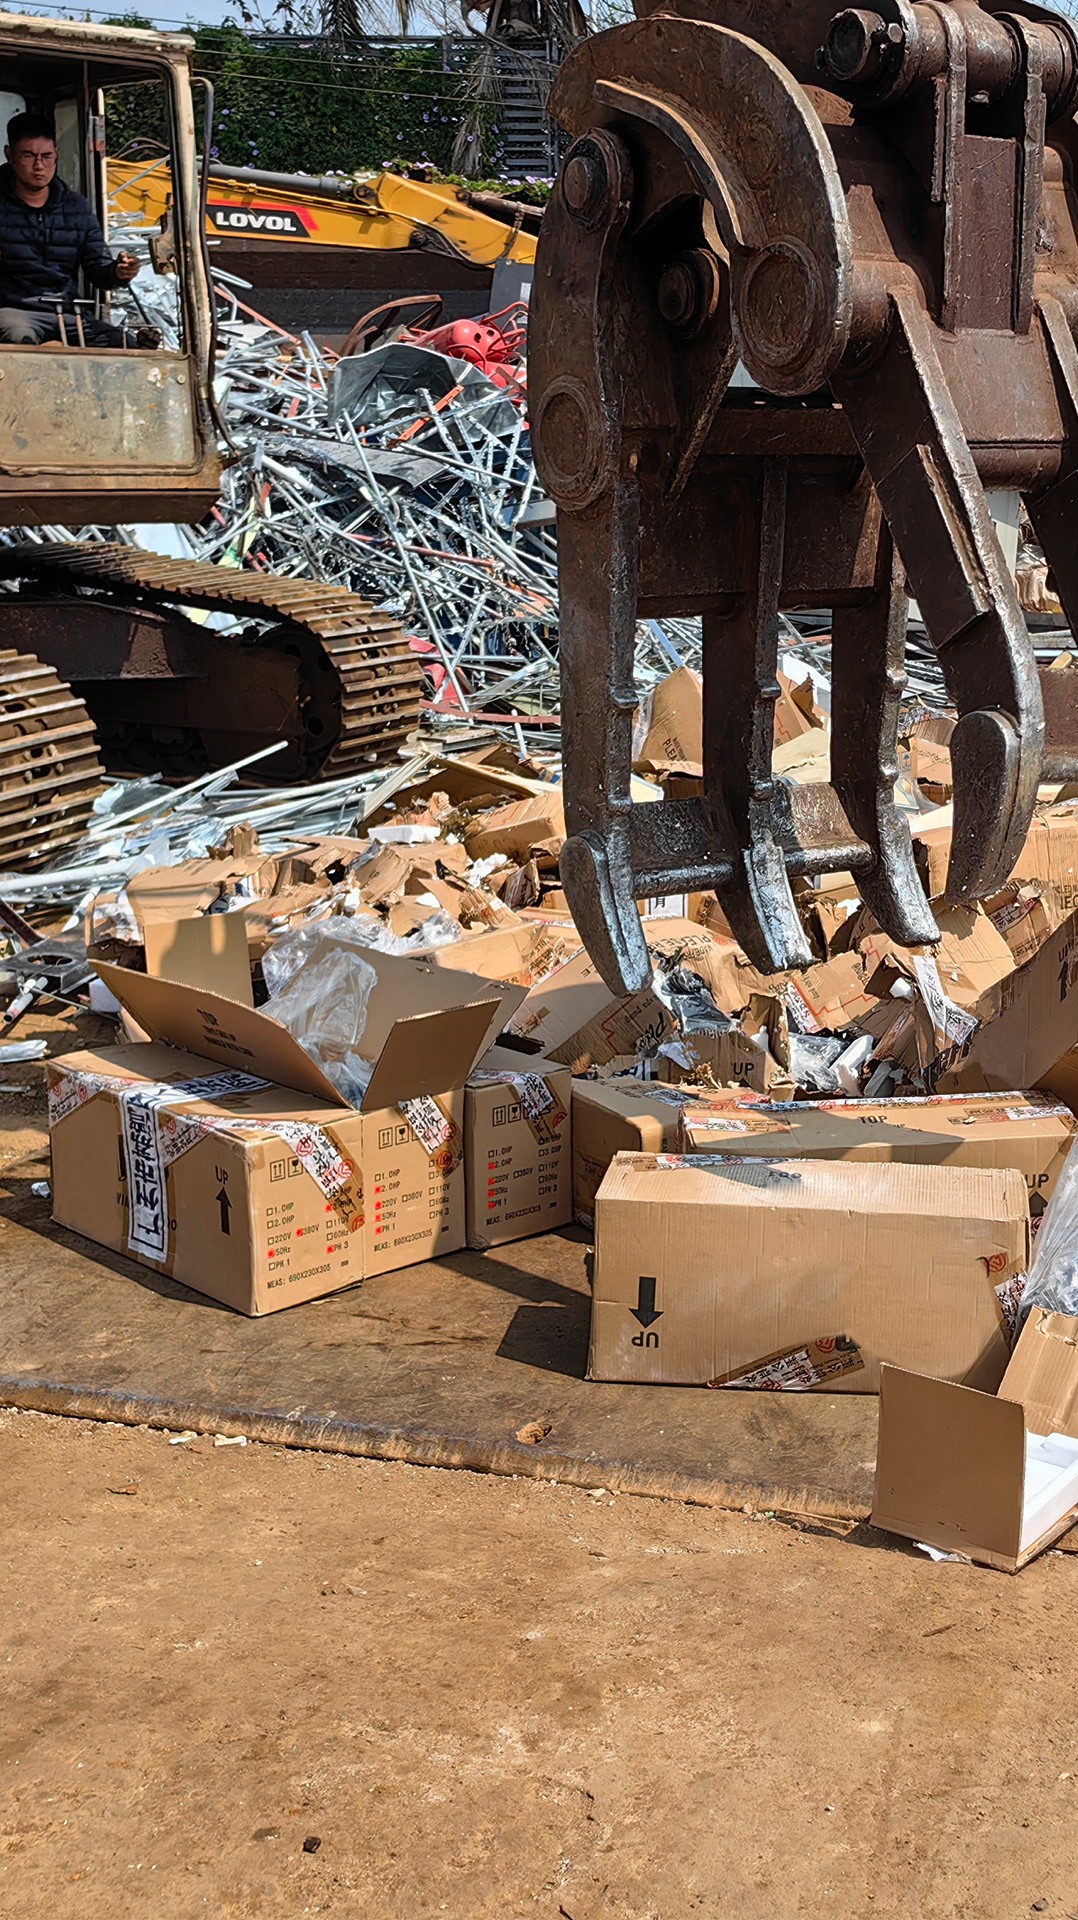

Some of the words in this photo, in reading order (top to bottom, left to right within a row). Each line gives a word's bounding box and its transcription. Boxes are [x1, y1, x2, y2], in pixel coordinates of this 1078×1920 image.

[216, 212, 297, 231] LOVOL
[733, 1062, 754, 1075] UP
[858, 1115, 887, 1124] TOP
[216, 1165, 229, 1185] UP
[381, 1169, 400, 1180] 1.0HP
[1025, 1173, 1049, 1188] UP
[381, 1181, 400, 1192] 2.0HP
[274, 1202, 294, 1214] 1.0HP
[274, 1215, 295, 1227] 2.0HP
[275, 1232, 292, 1244] 220V
[333, 1229, 349, 1239] 60Hz
[276, 1246, 291, 1256] 50Hz
[333, 1243, 342, 1252] PH
[343, 1241, 349, 1249] 3
[286, 1258, 290, 1266] 1
[267, 1278, 286, 1289] MEAS:
[288, 1263, 331, 1283] 690X230X305
[631, 1331, 659, 1348] UP
[743, 1349, 811, 1384] 广州公证处
